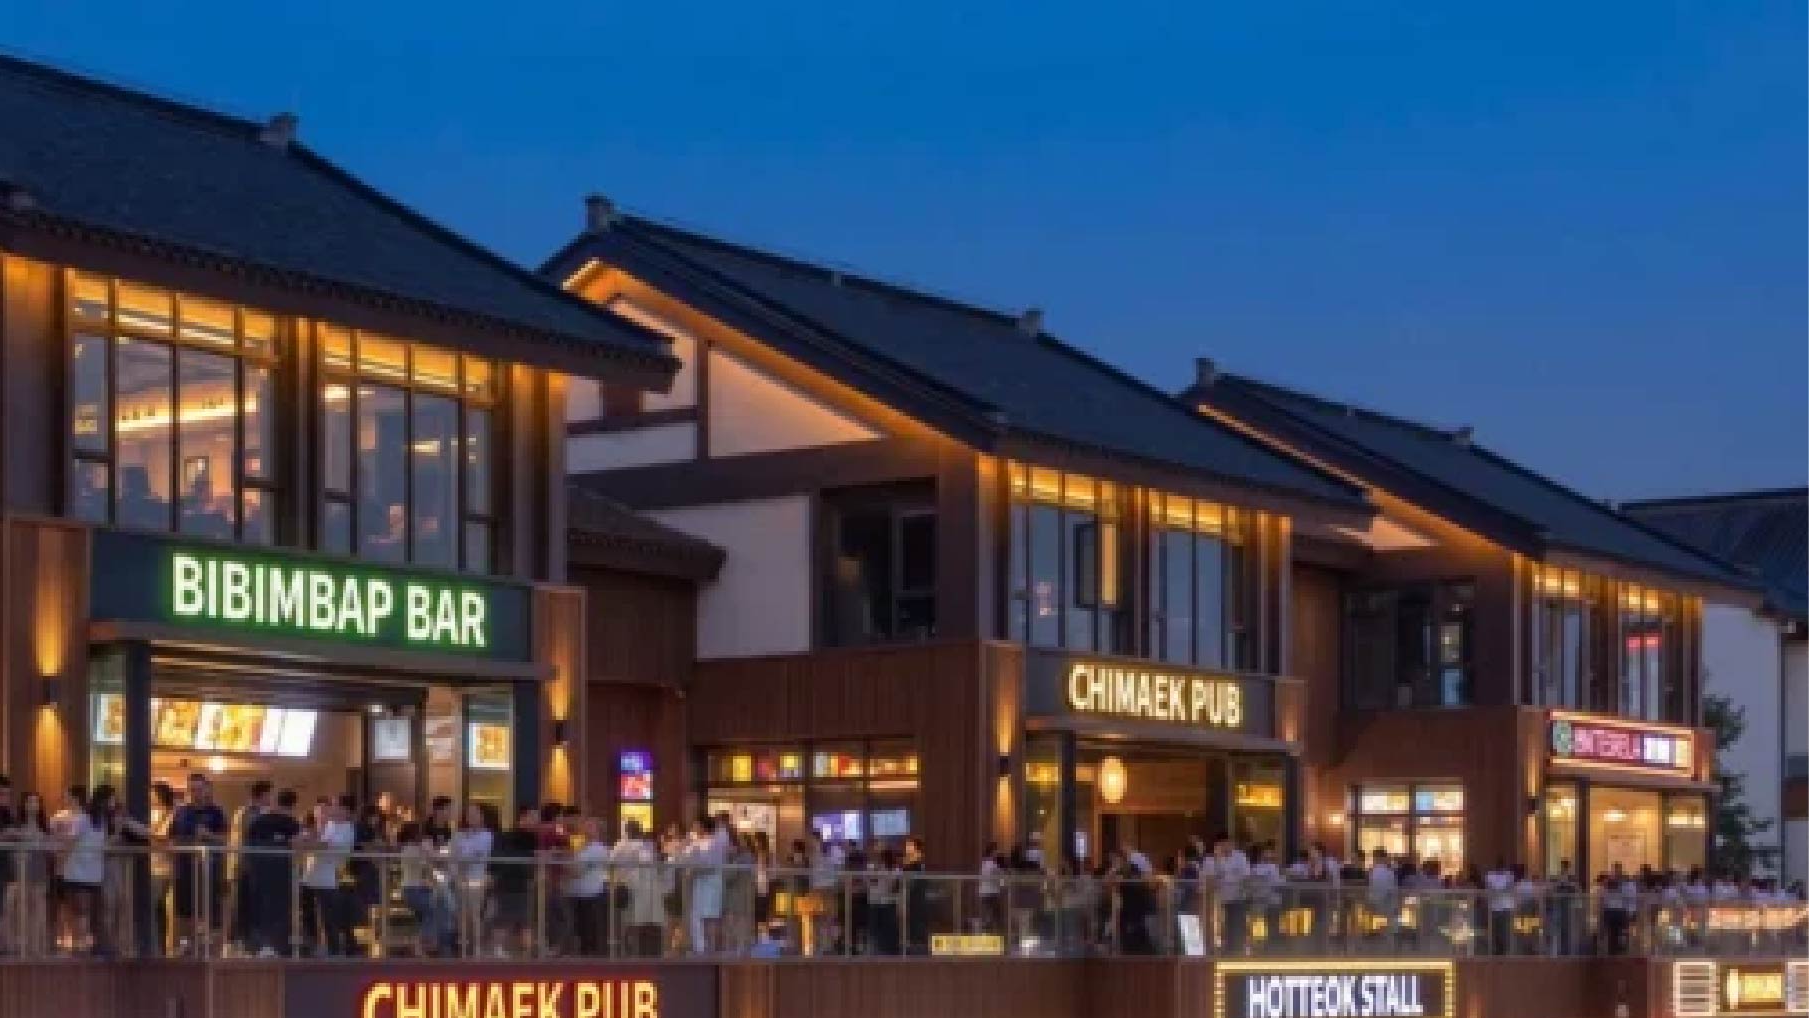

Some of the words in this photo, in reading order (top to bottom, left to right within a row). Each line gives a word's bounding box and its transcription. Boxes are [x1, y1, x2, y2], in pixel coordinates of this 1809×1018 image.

[171, 552, 394, 634] BIBIMBAP
[406, 584, 486, 647] BAR
[1068, 664, 1187, 721] CHIMAEK
[1191, 678, 1242, 728] PUB
[1361, 974, 1425, 1017] STALL
